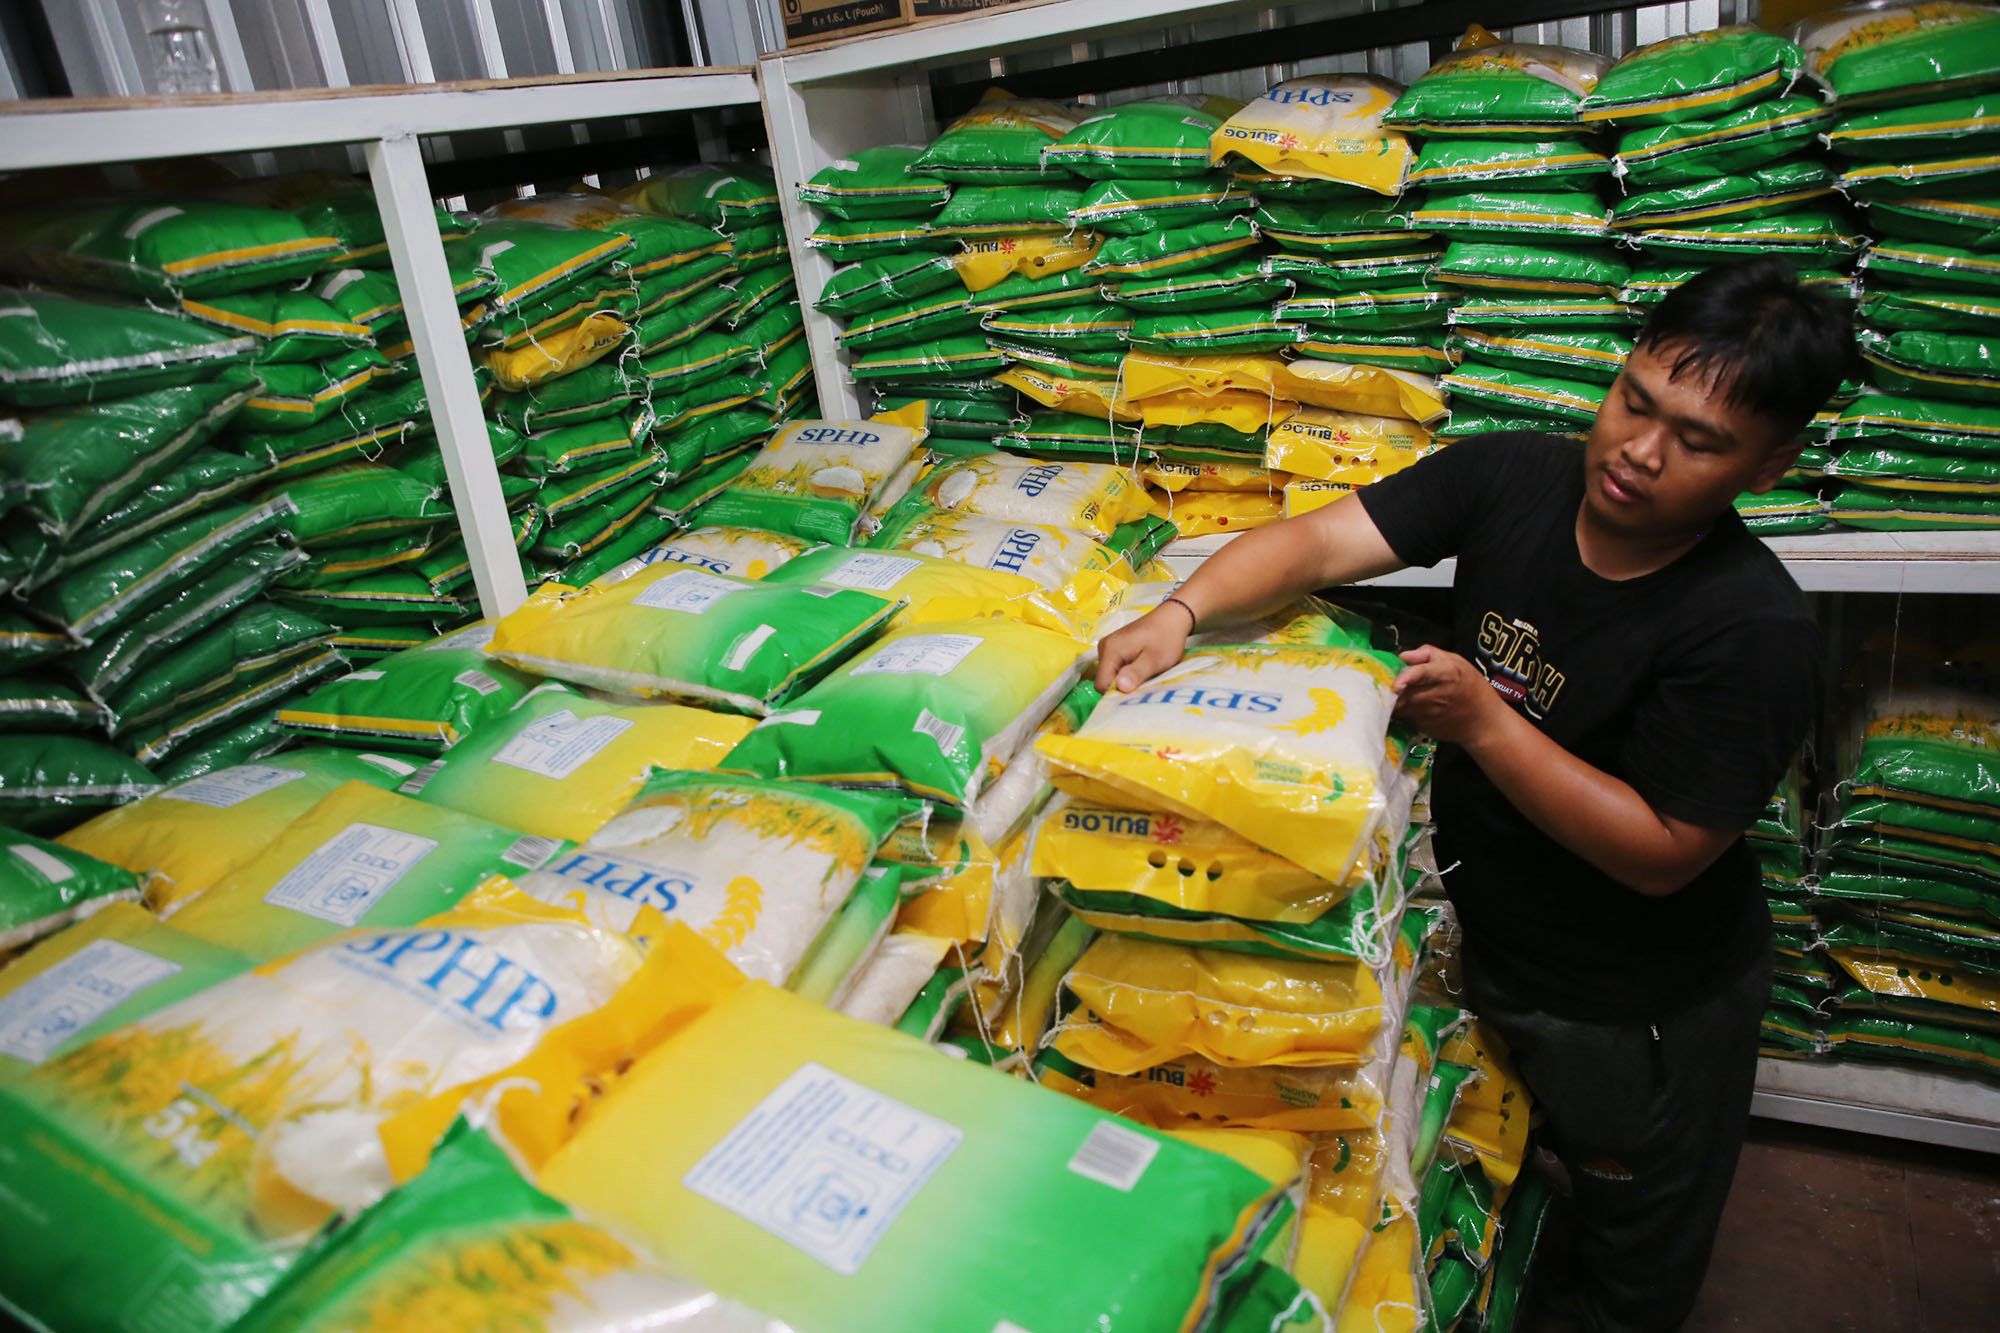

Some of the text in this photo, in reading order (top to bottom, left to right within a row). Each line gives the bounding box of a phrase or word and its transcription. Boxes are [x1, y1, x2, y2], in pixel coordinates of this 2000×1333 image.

[1224, 128, 1279, 144] BULOG
[963, 242, 998, 254] BULO
[796, 428, 880, 446] SPHP
[1282, 424, 1333, 440] BULOG
[1018, 465, 1064, 497] SPHP
[992, 529, 1041, 575] SPH
[1490, 679, 1523, 699] SEKUAT TV
[1118, 689, 1282, 713] SPHP
[1064, 813, 1150, 837] BULOG
[554, 854, 695, 912] SPH
